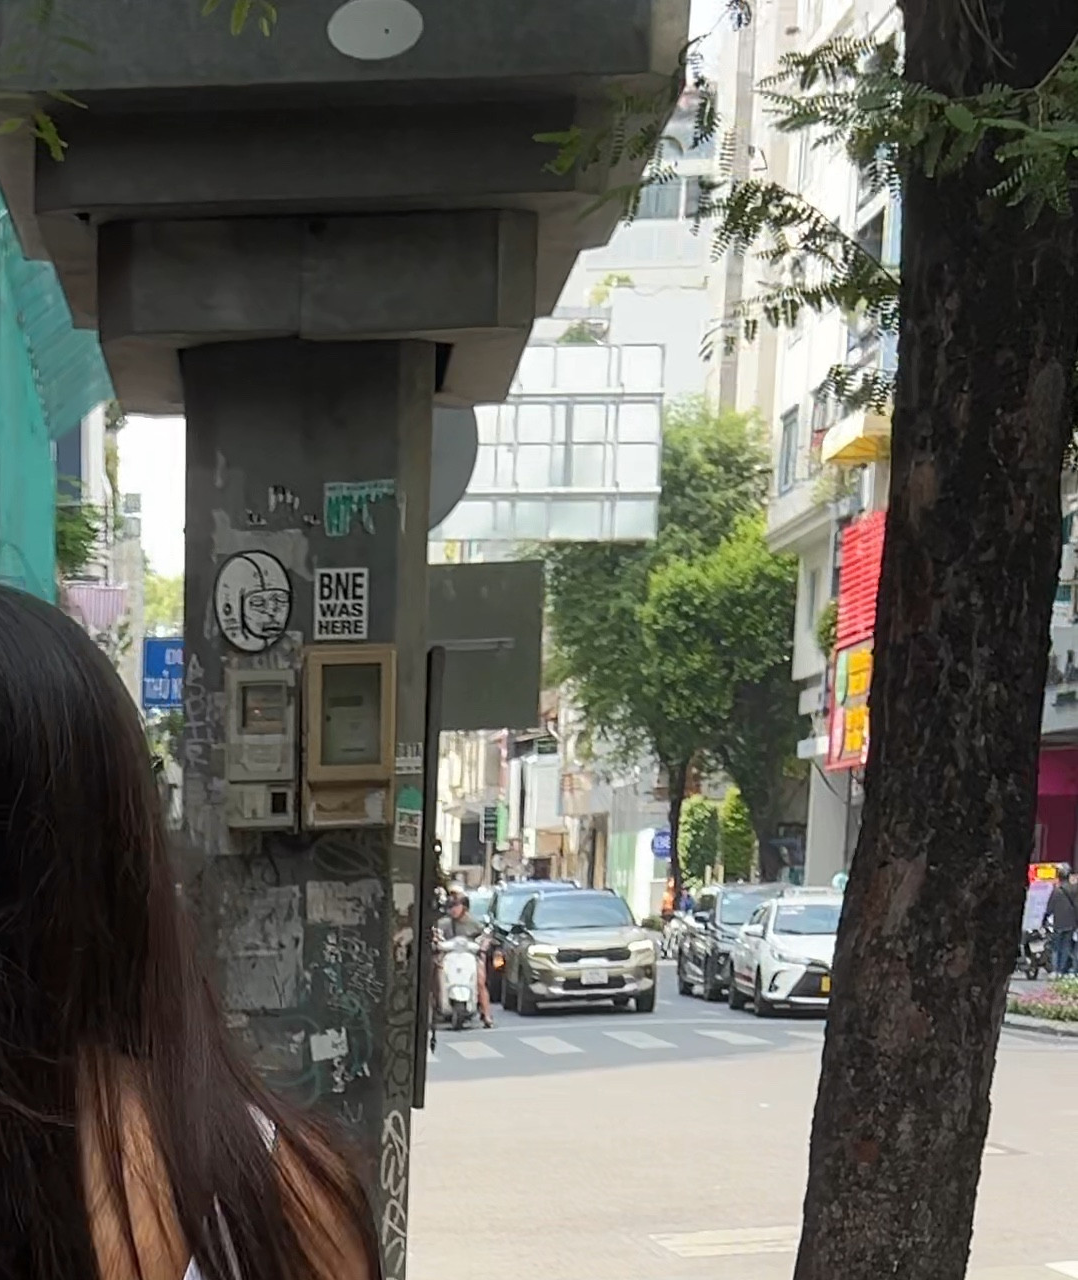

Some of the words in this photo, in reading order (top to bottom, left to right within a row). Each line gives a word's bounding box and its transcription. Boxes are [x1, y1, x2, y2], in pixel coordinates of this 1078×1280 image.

[320, 573, 364, 600] BNE
[320, 603, 363, 617] WAS
[319, 620, 364, 635] HERE
